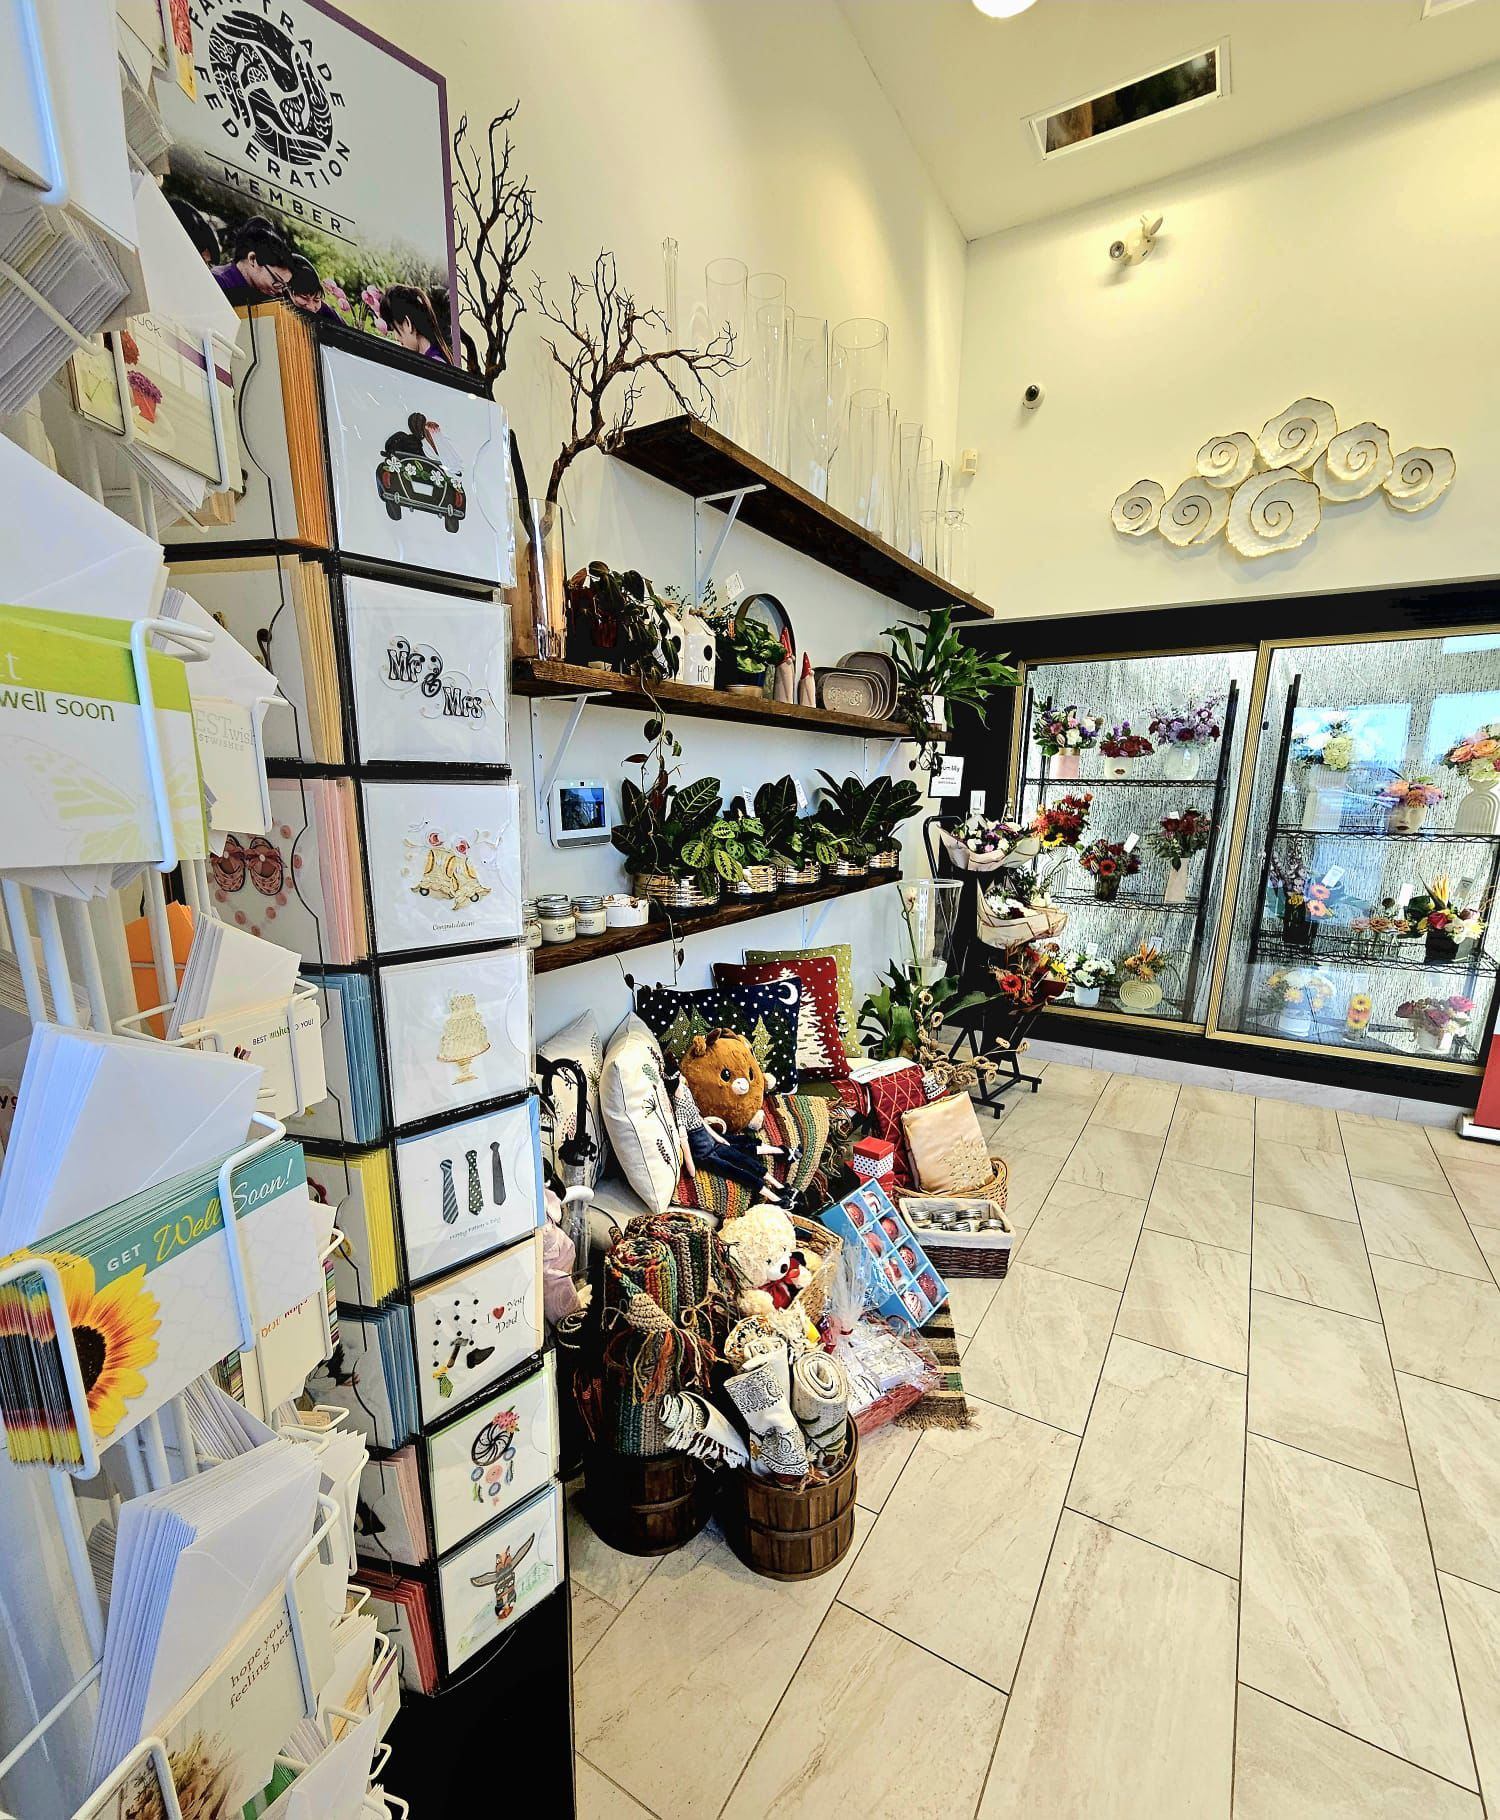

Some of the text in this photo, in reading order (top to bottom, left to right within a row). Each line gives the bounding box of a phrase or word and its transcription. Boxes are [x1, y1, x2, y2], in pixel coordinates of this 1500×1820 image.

[189, 0, 242, 31] FA
[194, 65, 351, 189] FEDERATION
[223, 166, 343, 234] MEMBER
[387, 640, 425, 683] Mr
[442, 686, 484, 719] Mrs
[697, 664, 713, 683] HO
[55, 698, 116, 722] soon
[193, 709, 232, 739] EST
[252, 1034, 268, 1046] BEST
[106, 1158, 294, 1272] GET Well Soon!
[229, 1655, 271, 1711] feeling
[230, 1648, 262, 1689] hope
